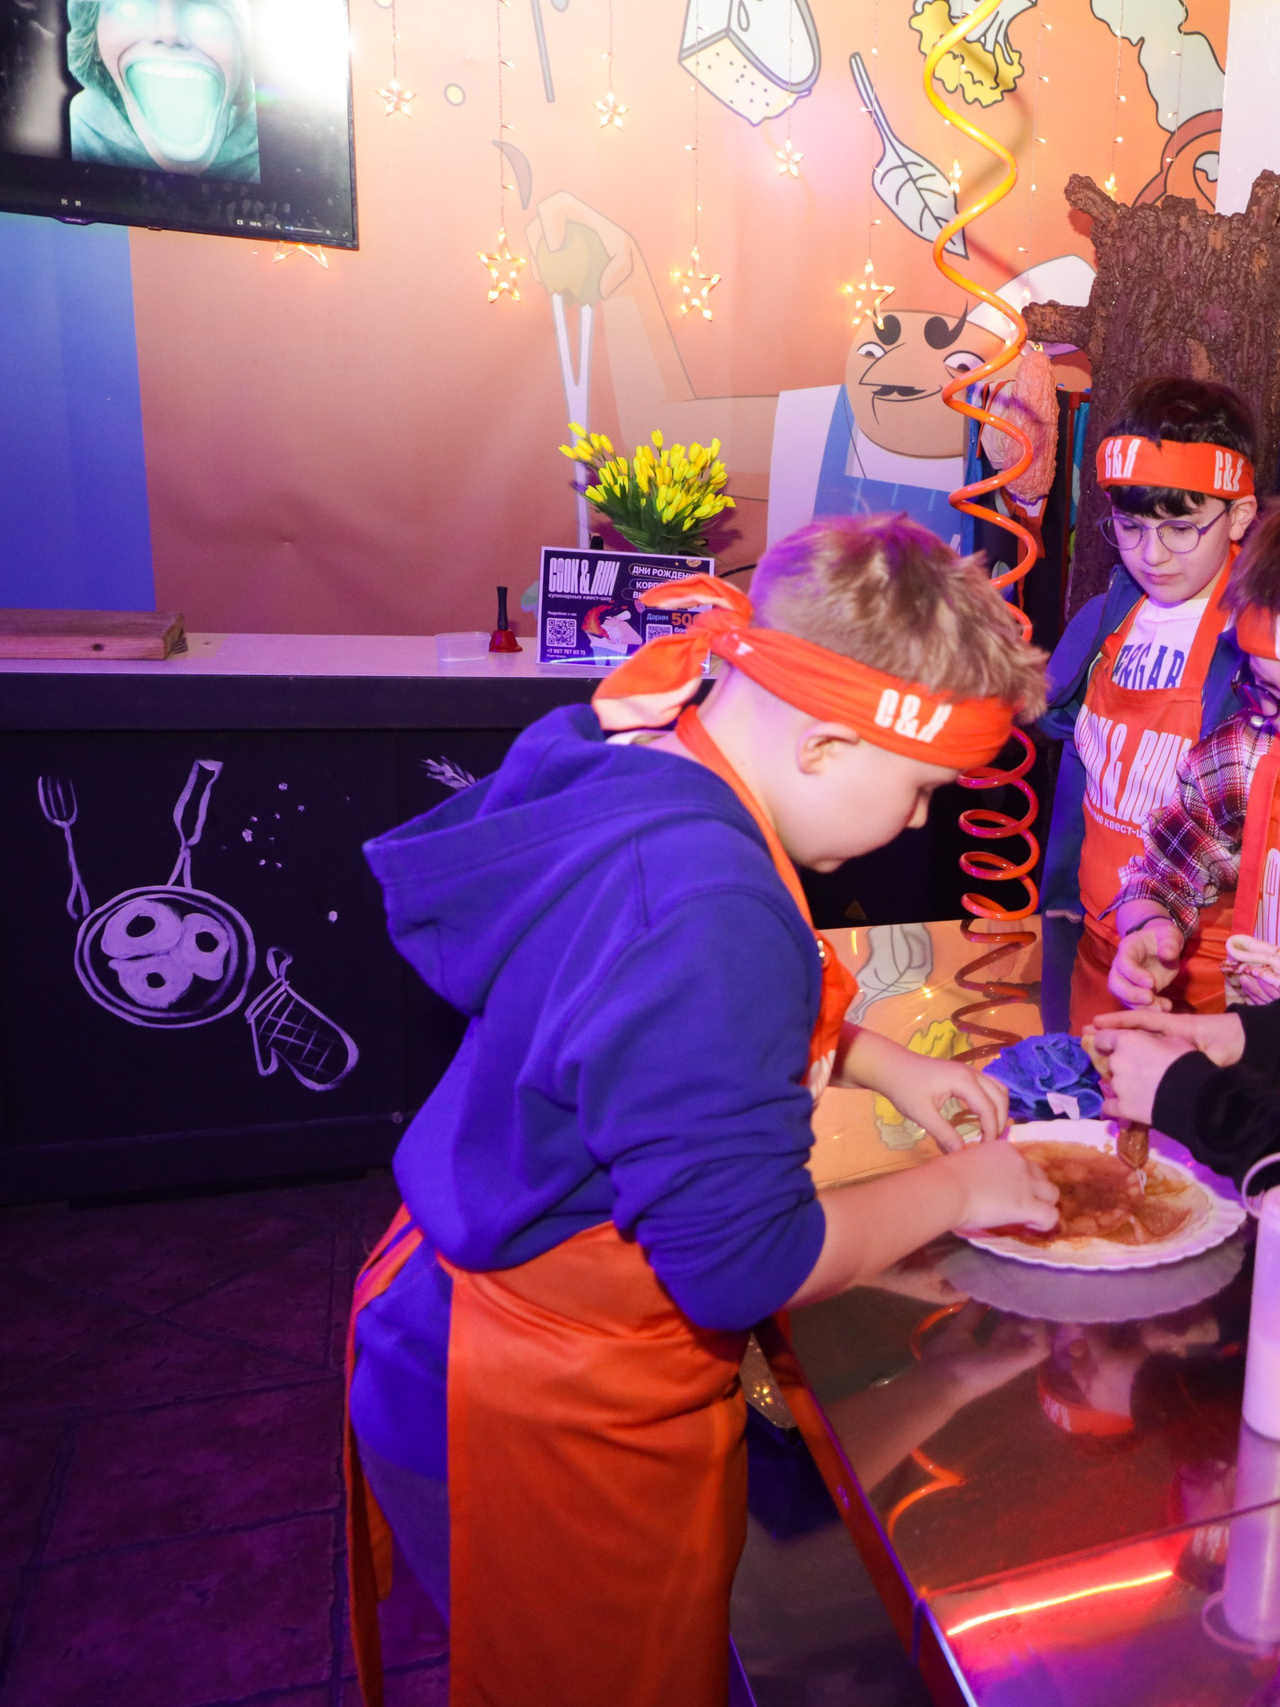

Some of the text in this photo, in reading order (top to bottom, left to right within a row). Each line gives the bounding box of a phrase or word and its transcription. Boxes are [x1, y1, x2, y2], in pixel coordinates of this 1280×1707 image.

[1105, 439, 1141, 478] C&R
[1213, 450, 1244, 492] C&R
[549, 557, 620, 596] COOK & RUN
[632, 566, 650, 575] ДНИ
[636, 581, 666, 589] КОРП
[874, 688, 953, 743] C&R
[1102, 723, 1128, 818] &
